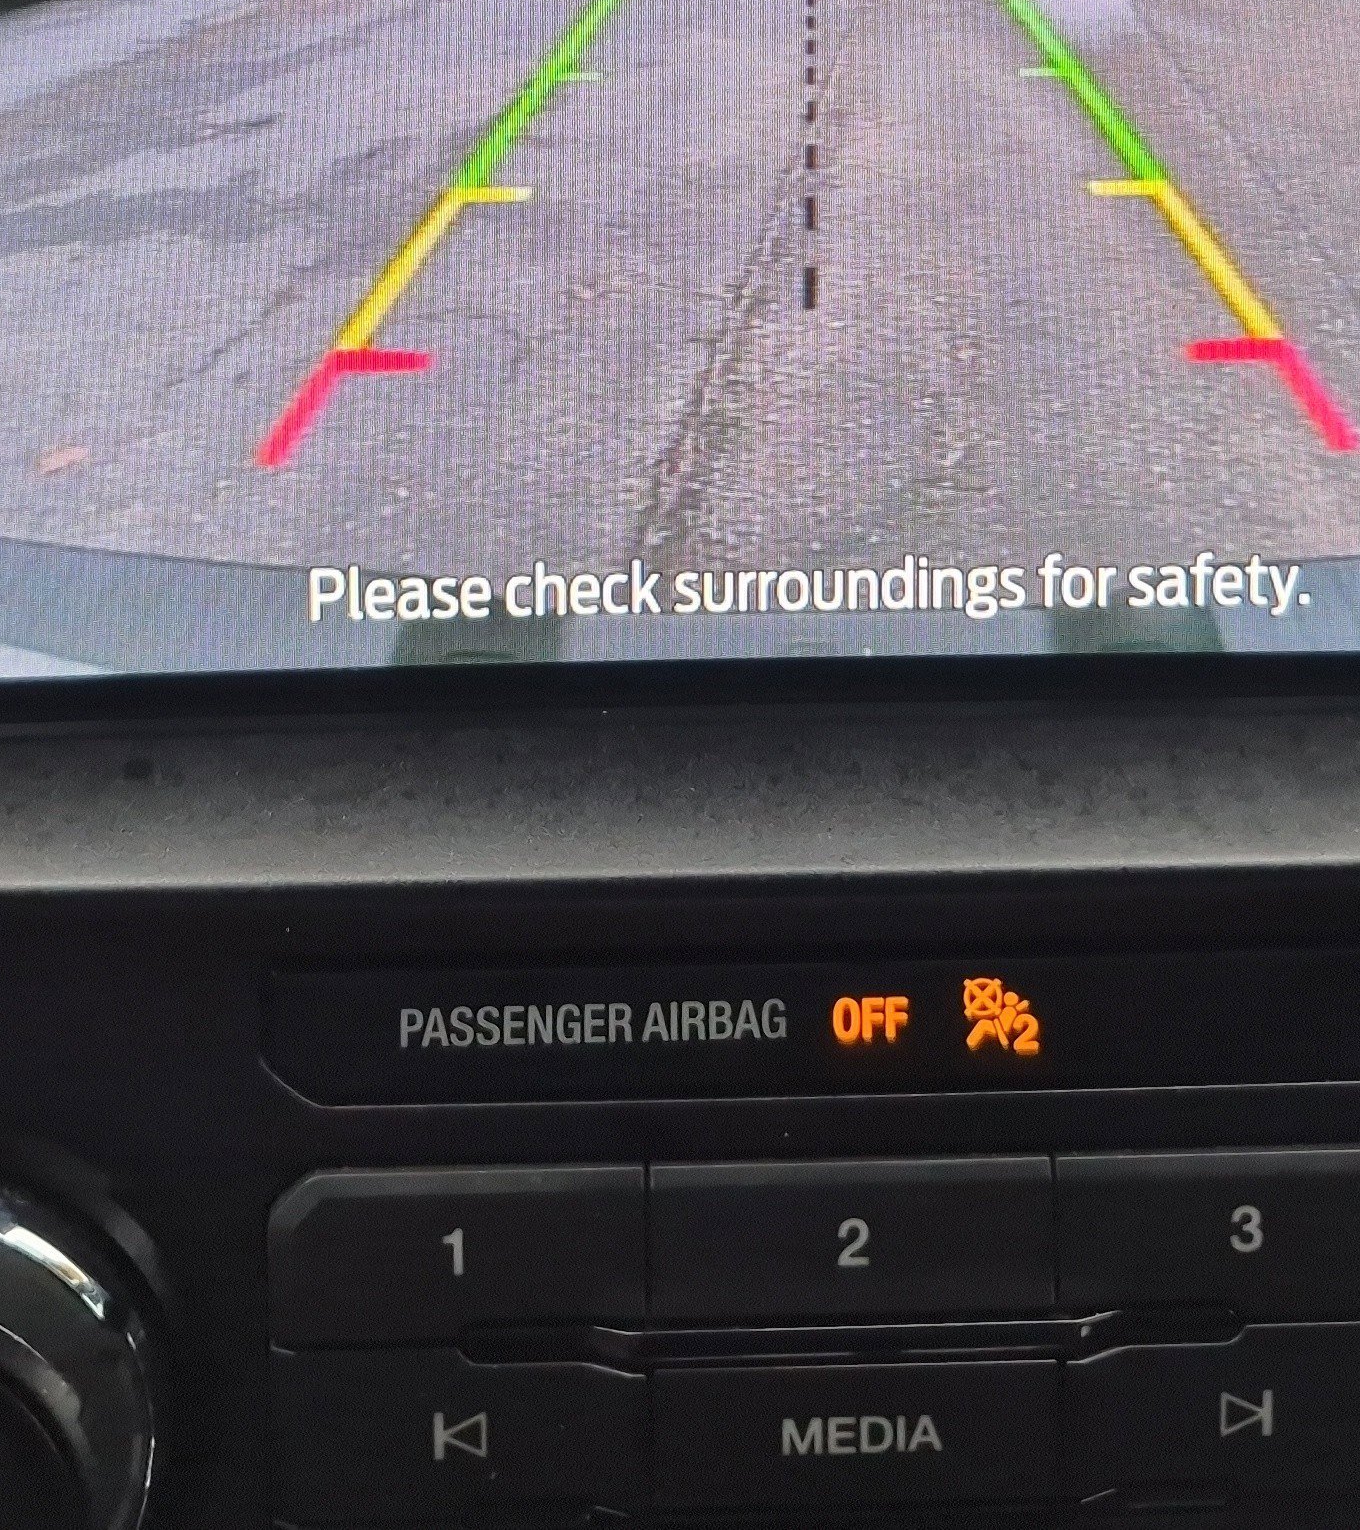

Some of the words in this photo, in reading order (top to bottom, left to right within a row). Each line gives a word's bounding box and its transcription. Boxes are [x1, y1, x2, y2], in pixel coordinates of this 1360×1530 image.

[309, 565, 491, 622] Please
[505, 560, 661, 616] check
[673, 555, 1026, 619] surroundings
[1038, 553, 1116, 608] for
[1127, 551, 1311, 616] safety.
[399, 1004, 634, 1048] PASSENGER
[642, 998, 787, 1042] AIRBAG
[833, 995, 909, 1042] OFF
[443, 1227, 466, 1276] 1
[837, 1218, 871, 1267] 2
[1230, 1205, 1264, 1253] 3
[781, 1415, 943, 1456] MEDIA
